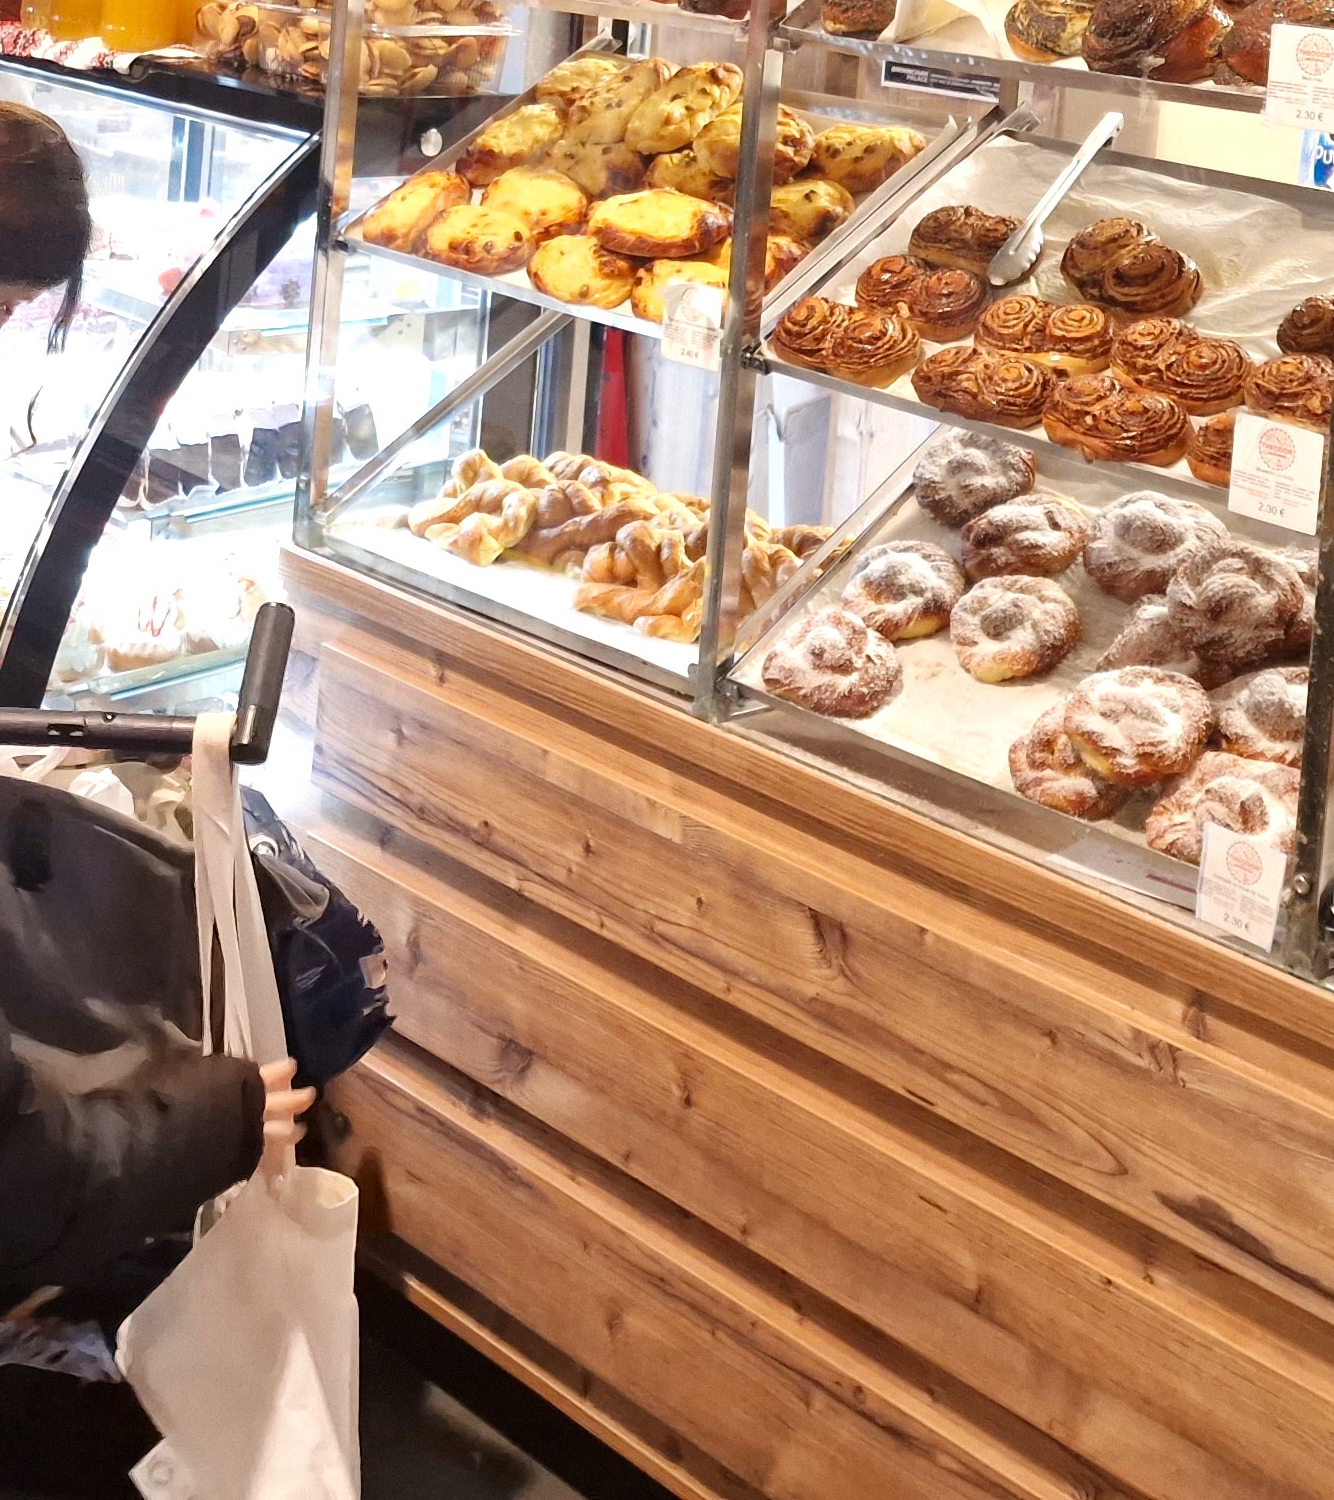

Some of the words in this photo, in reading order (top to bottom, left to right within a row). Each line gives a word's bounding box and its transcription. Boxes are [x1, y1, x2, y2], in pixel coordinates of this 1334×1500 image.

[1296, 109, 1316, 121] 2.30
[1317, 112, 1324, 122] €
[1258, 501, 1277, 516] 2.30
[1279, 508, 1286, 518] €
